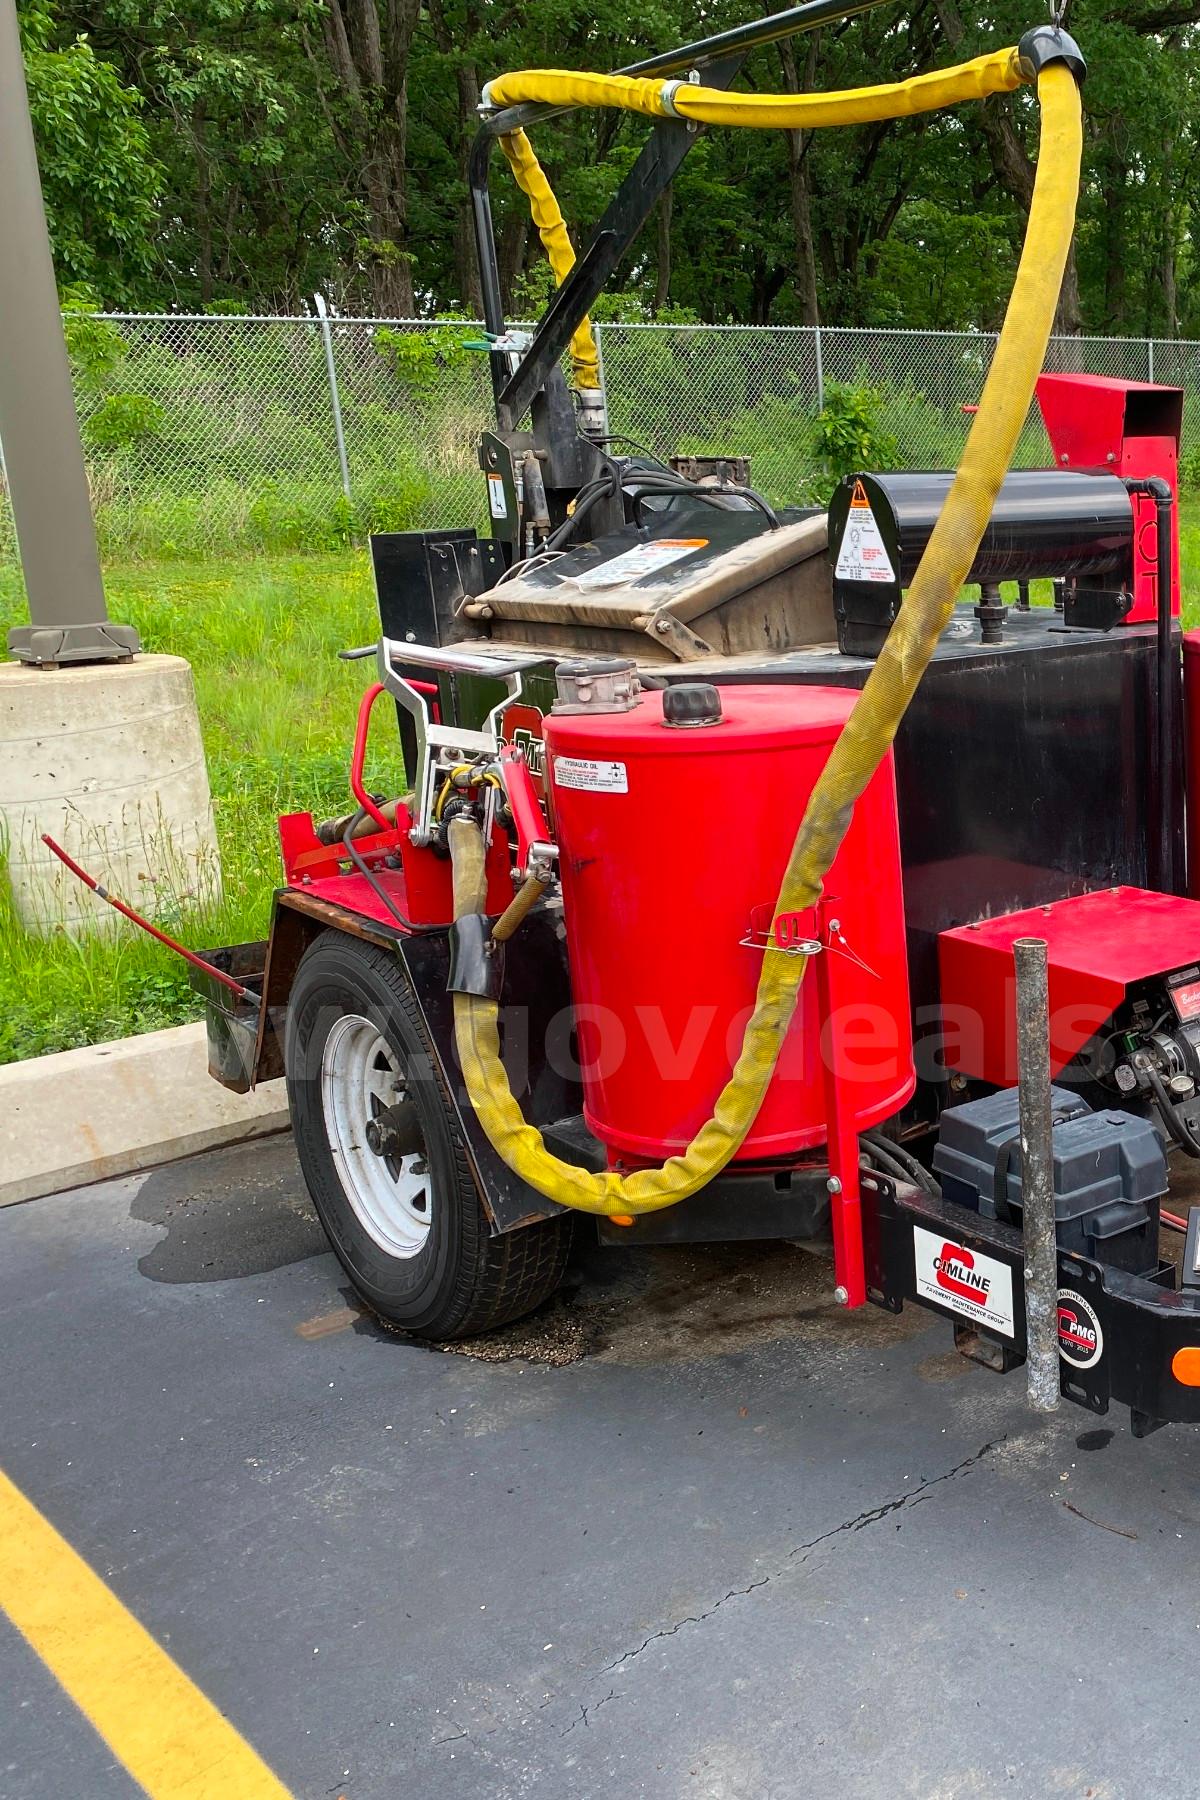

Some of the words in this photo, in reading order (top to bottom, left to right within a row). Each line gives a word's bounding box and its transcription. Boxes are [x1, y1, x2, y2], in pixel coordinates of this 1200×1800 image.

[933, 1257, 991, 1292] CIMLINE
[925, 1286, 951, 1301] PAVEMENT
[951, 1297, 987, 1318] MAINTENANCE
[986, 1314, 1005, 1326] GROUP
[1060, 1289, 1098, 1320] ANNIVERSARY
[1069, 1322, 1096, 1342] PMG
